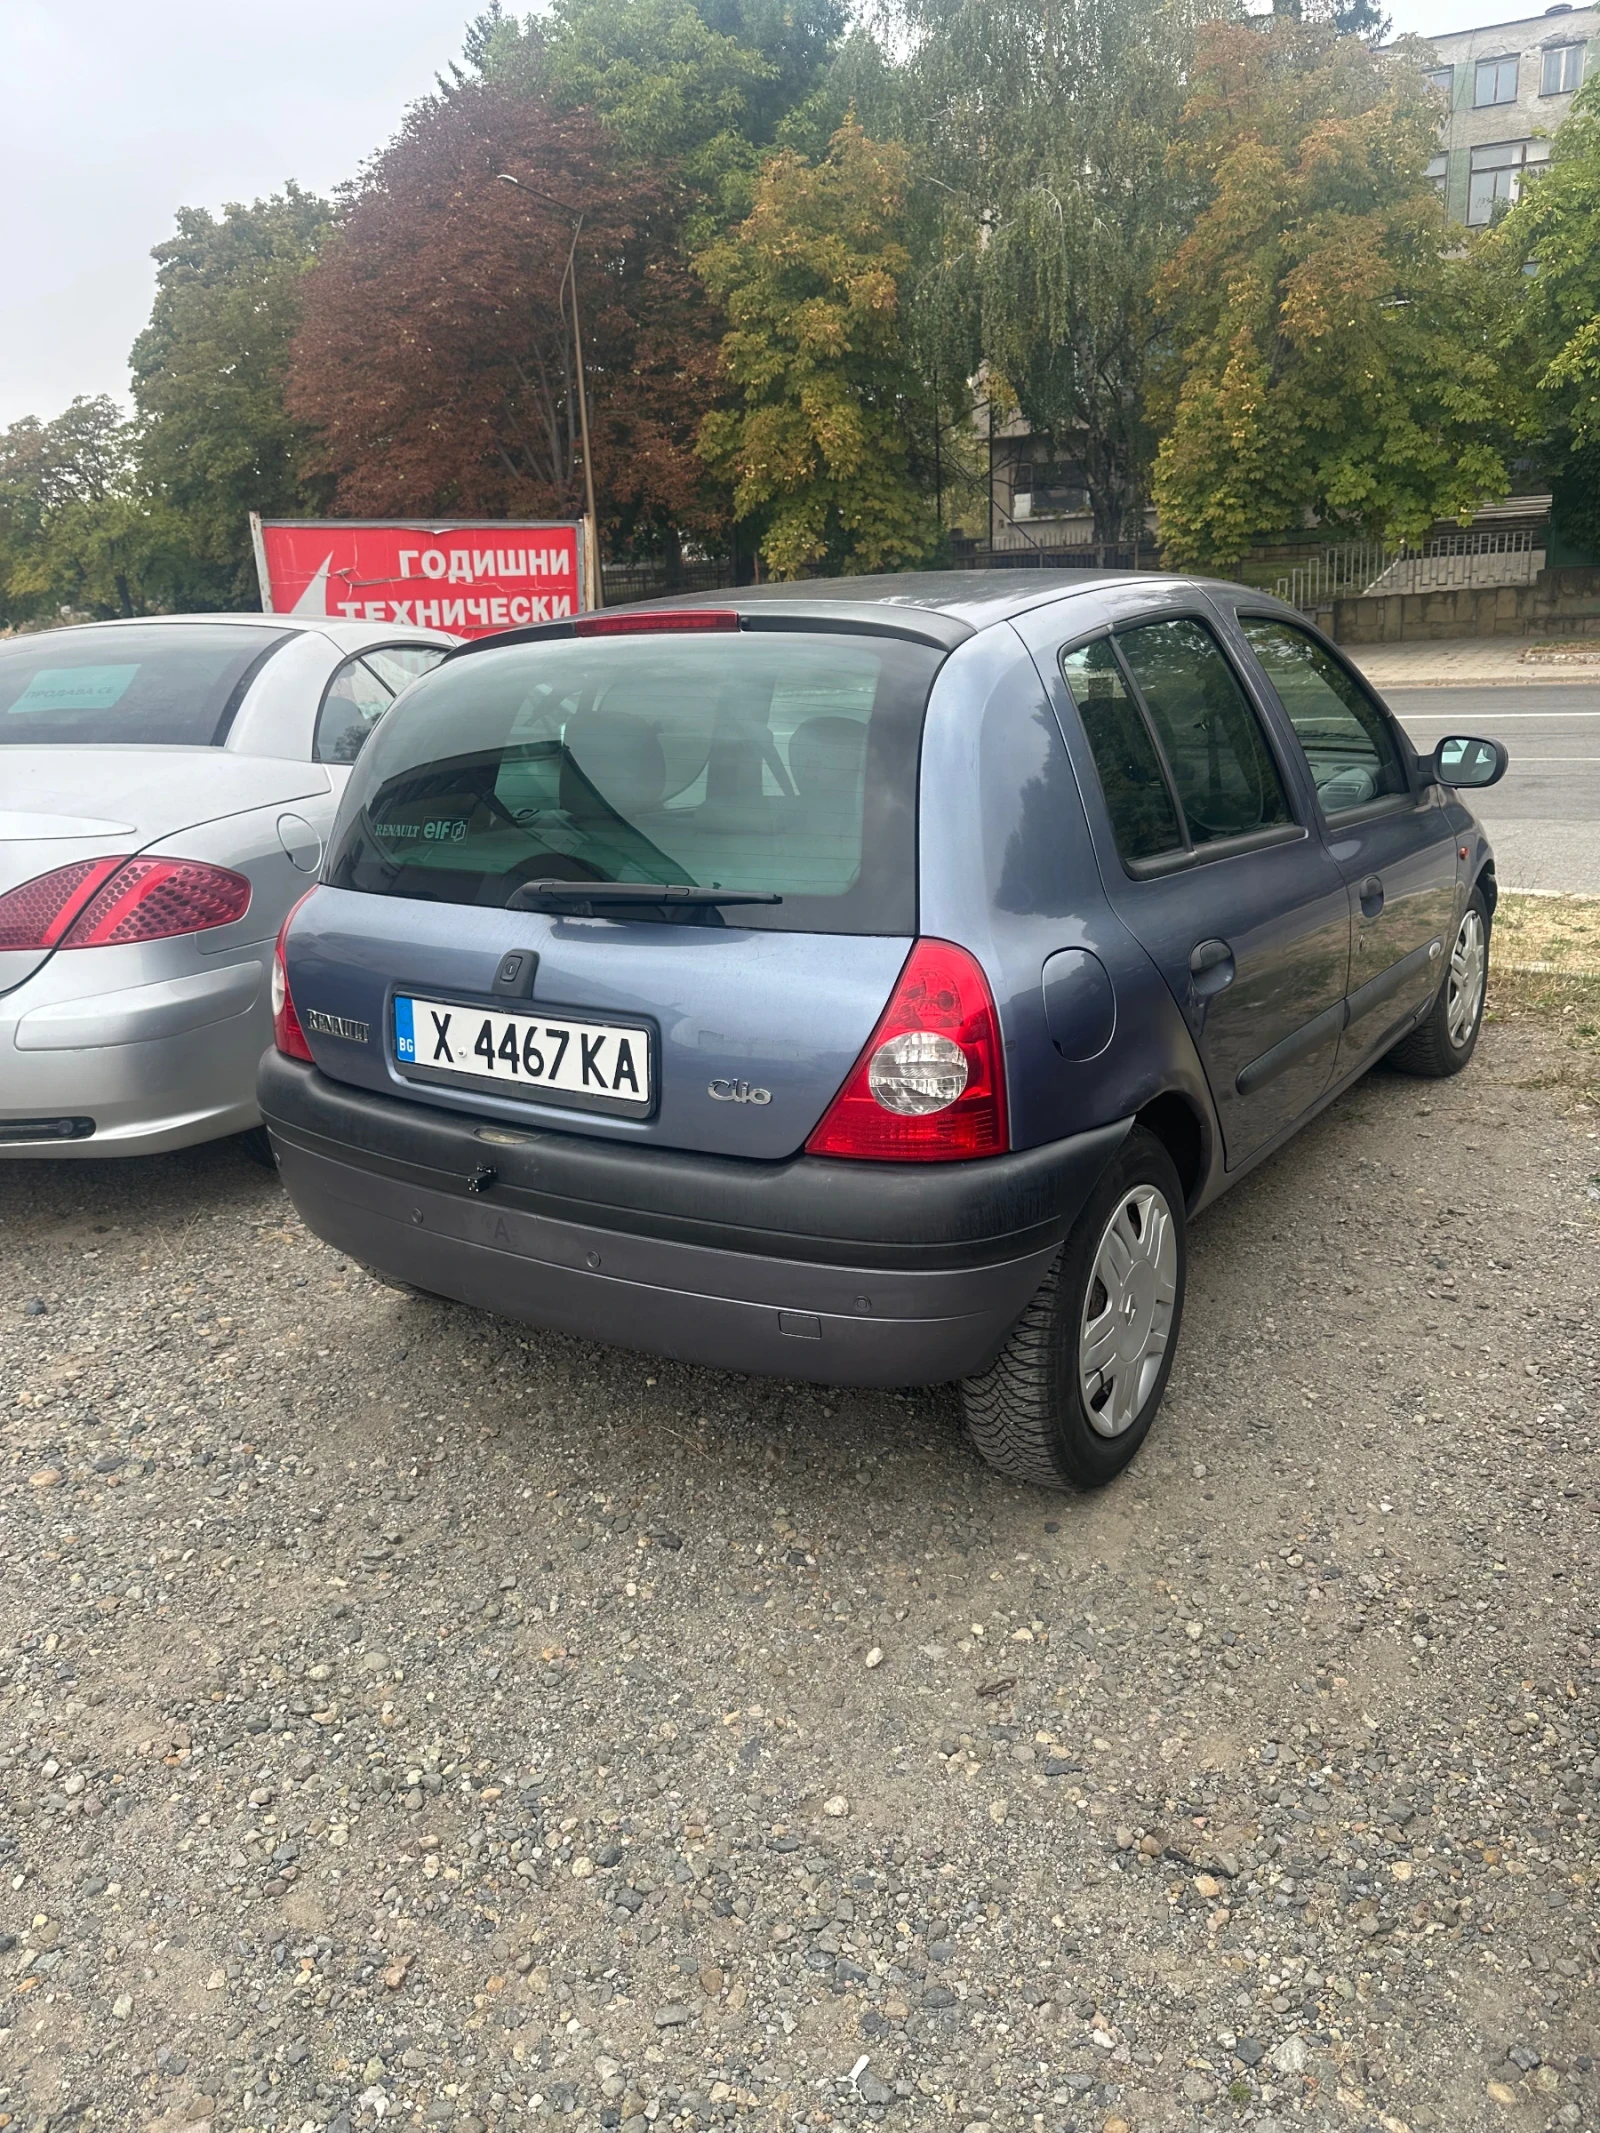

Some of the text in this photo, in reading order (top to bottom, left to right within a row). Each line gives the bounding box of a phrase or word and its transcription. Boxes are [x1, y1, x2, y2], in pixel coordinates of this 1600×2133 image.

[398, 548, 570, 583] ГОДИШНИ
[336, 595, 572, 628] ТЕХНИЧЕСКИ
[374, 820, 451, 840] RENAULT elf
[306, 1008, 370, 1044] RENAULT
[399, 1037, 414, 1053] BG
[431, 1010, 639, 1093] X 4467 KA
[707, 1078, 772, 1105] Clio
